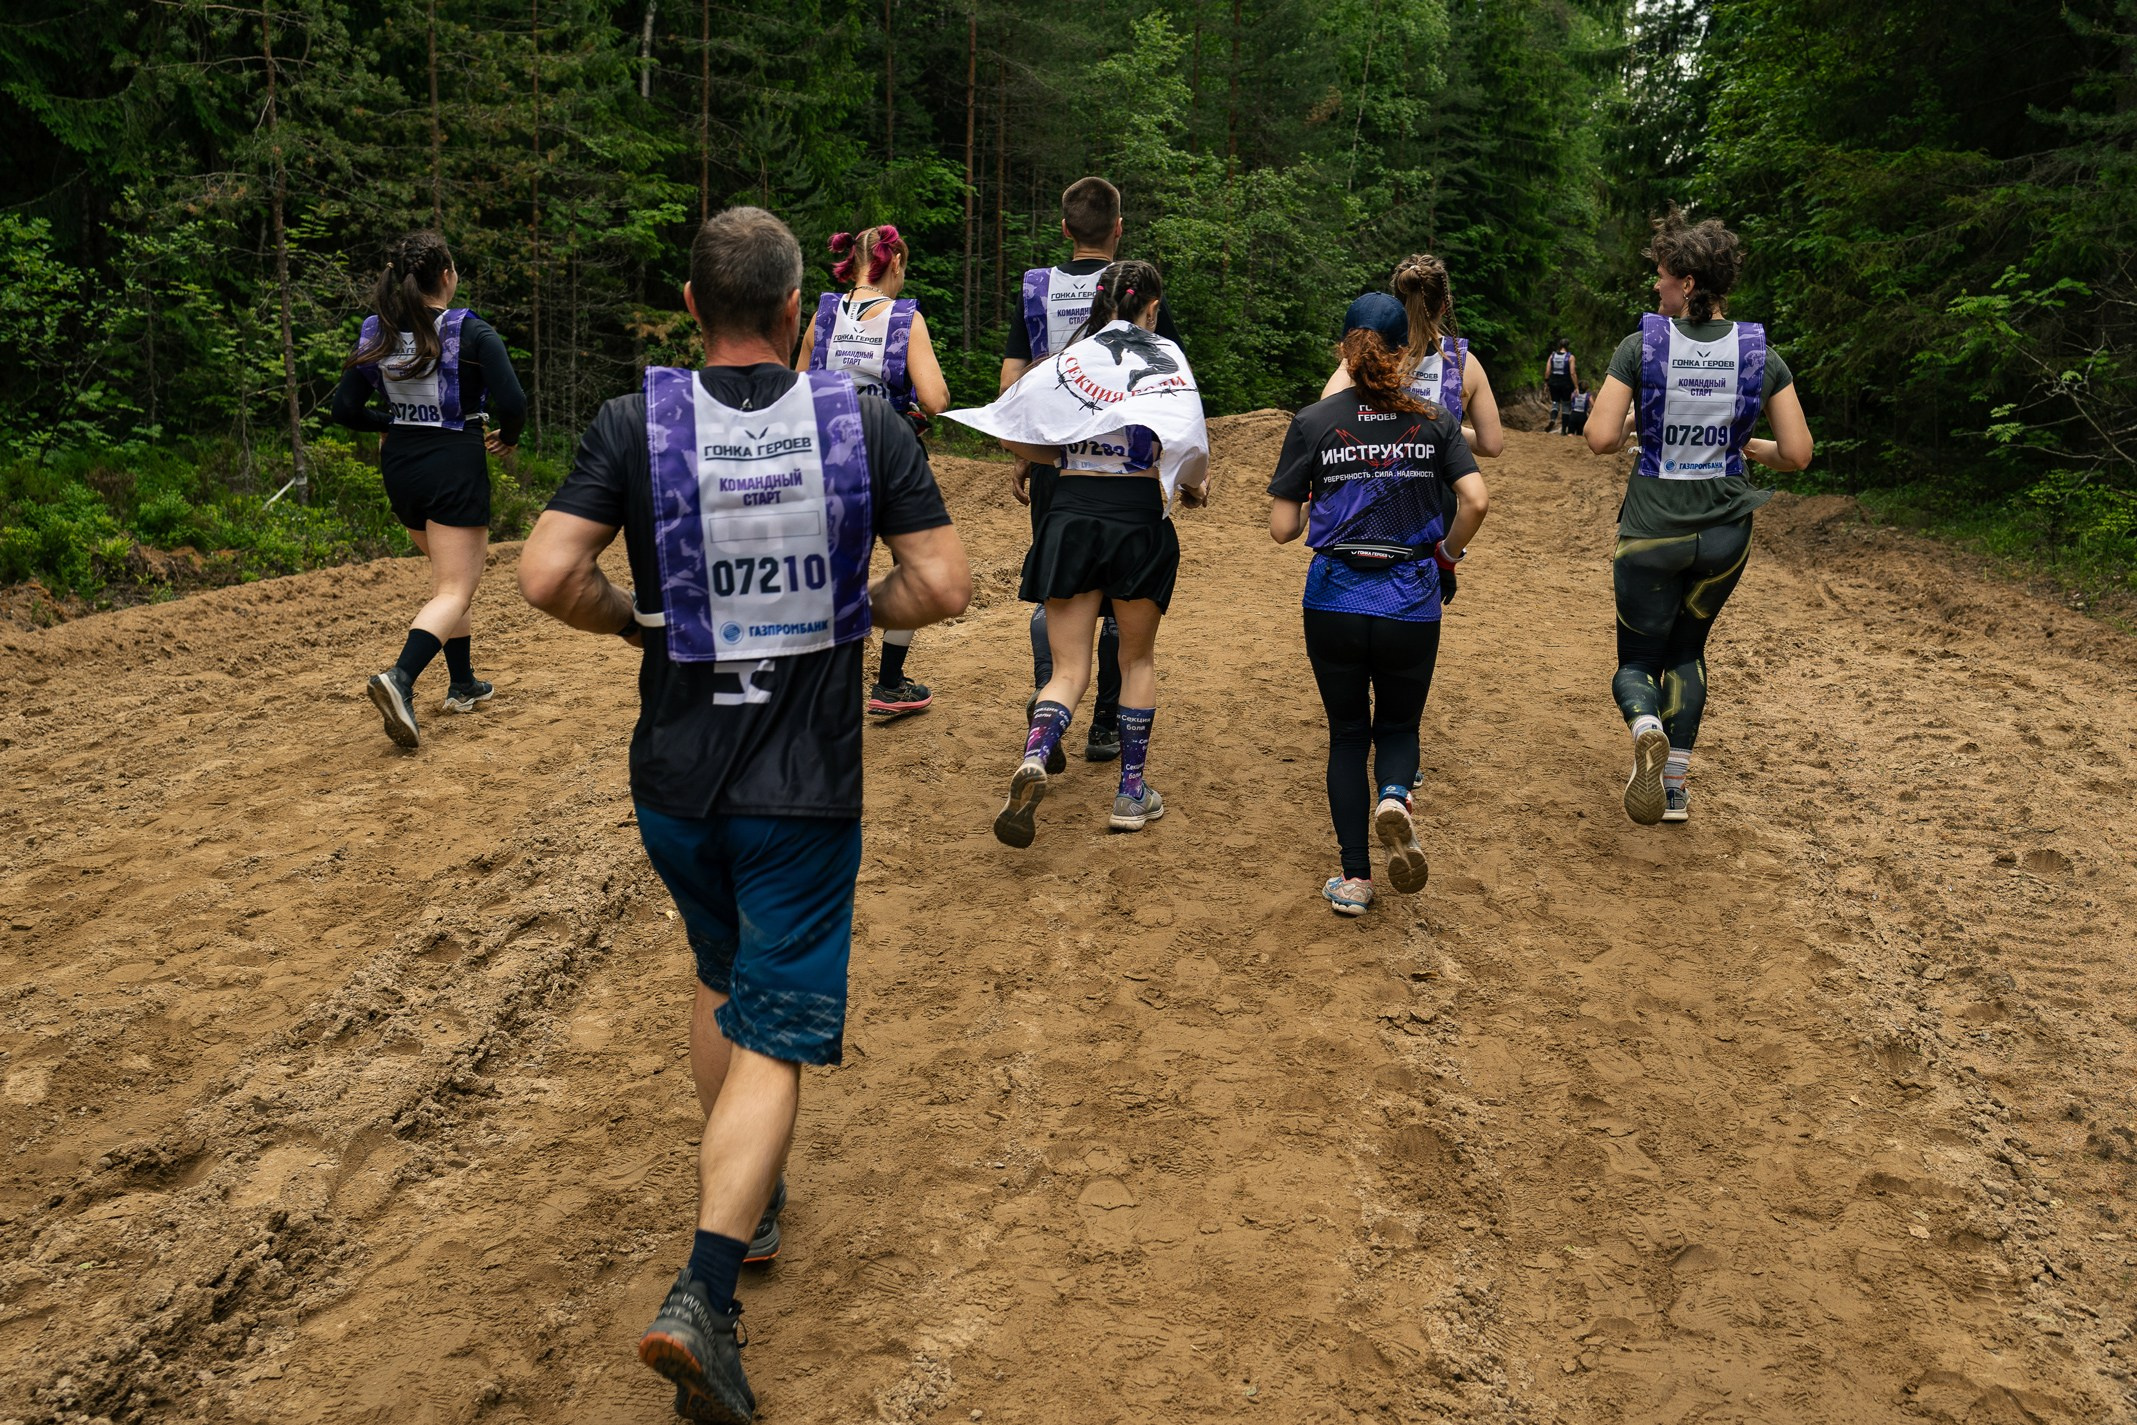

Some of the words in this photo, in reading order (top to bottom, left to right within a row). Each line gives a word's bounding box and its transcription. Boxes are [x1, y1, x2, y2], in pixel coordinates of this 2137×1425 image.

[1051, 291, 1076, 299] ГОНКА
[1057, 307, 1092, 317] КОМАНДН
[835, 350, 874, 359] КОМАНДНЫЙ
[843, 357, 861, 365] СТАРТ
[1672, 359, 1700, 367] ГОНКА
[1702, 360, 1735, 368] ГЕРОЕВ
[1065, 357, 1125, 403] СЕКЦИЯ
[1678, 378, 1726, 388] КОМАНДНЫЙ
[1690, 388, 1712, 396] СТАРТ
[1357, 413, 1398, 422] ГЕРОЕВ
[1665, 424, 1728, 446] 07209
[704, 445, 752, 457] ГОНКА
[757, 437, 812, 456] ГЕРОЕВ
[1321, 443, 1435, 466] ИНСТРУКТОР
[1679, 462, 1723, 470] ГАЗПРОМБАНК
[719, 468, 803, 492] КОМАНДНЫЙ
[743, 490, 781, 506] СТАРТ
[712, 553, 826, 597] 07210
[749, 620, 829, 638] ГАЗПРОМБАНК
